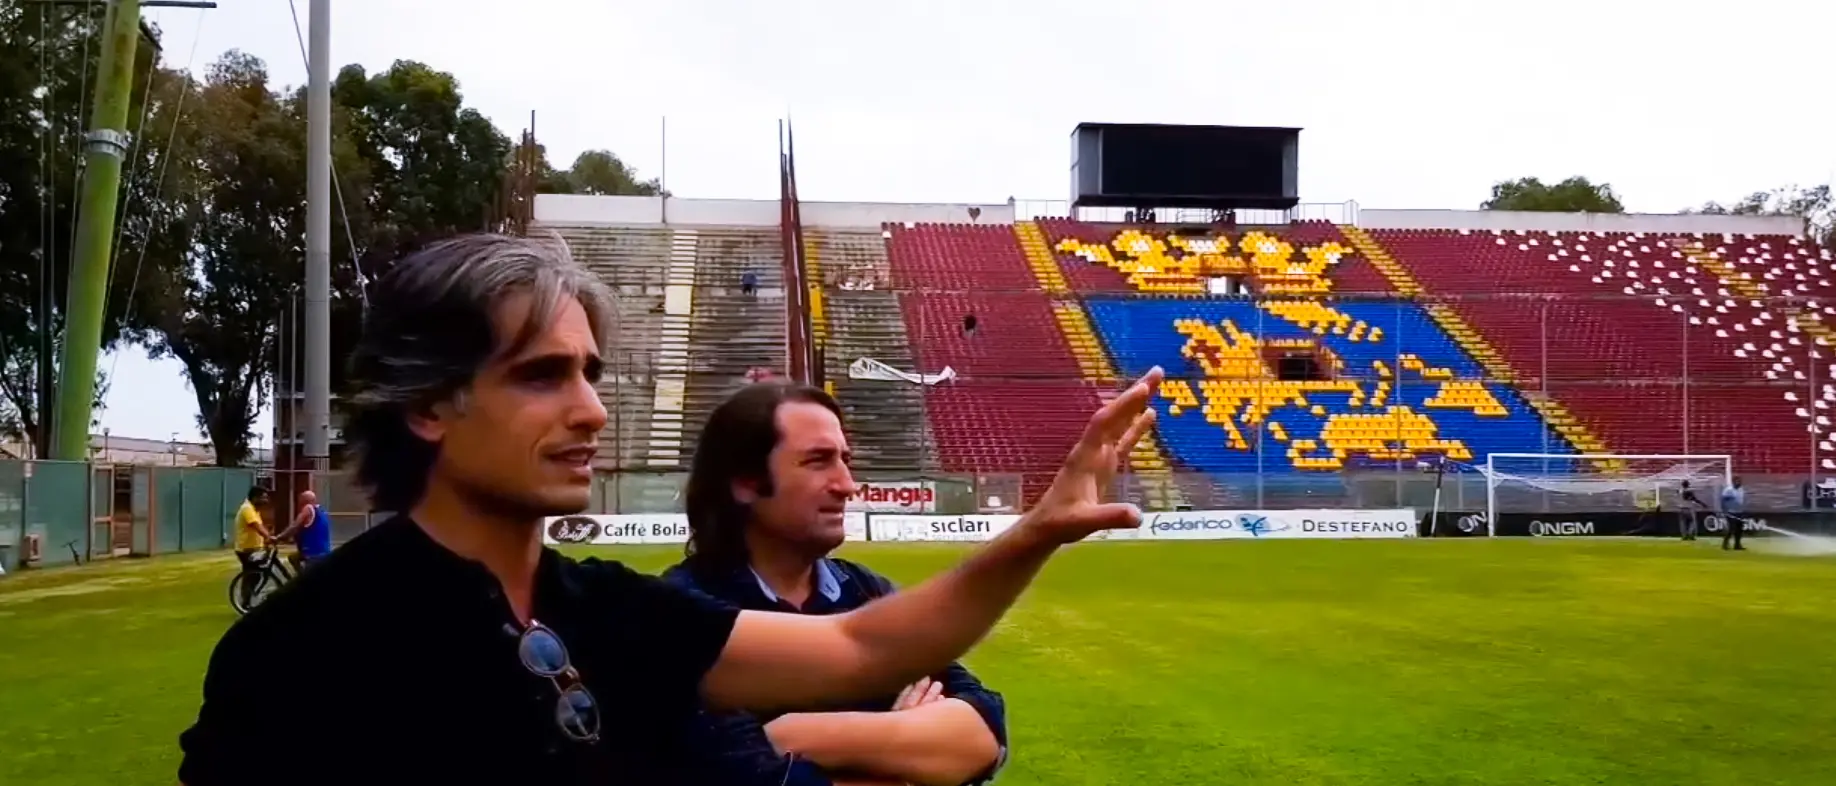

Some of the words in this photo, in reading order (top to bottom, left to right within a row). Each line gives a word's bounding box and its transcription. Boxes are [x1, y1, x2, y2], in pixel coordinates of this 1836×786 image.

[931, 517, 990, 533] siclari
[1149, 514, 1232, 535] federico
[1302, 519, 1408, 533] DESTEFANO
